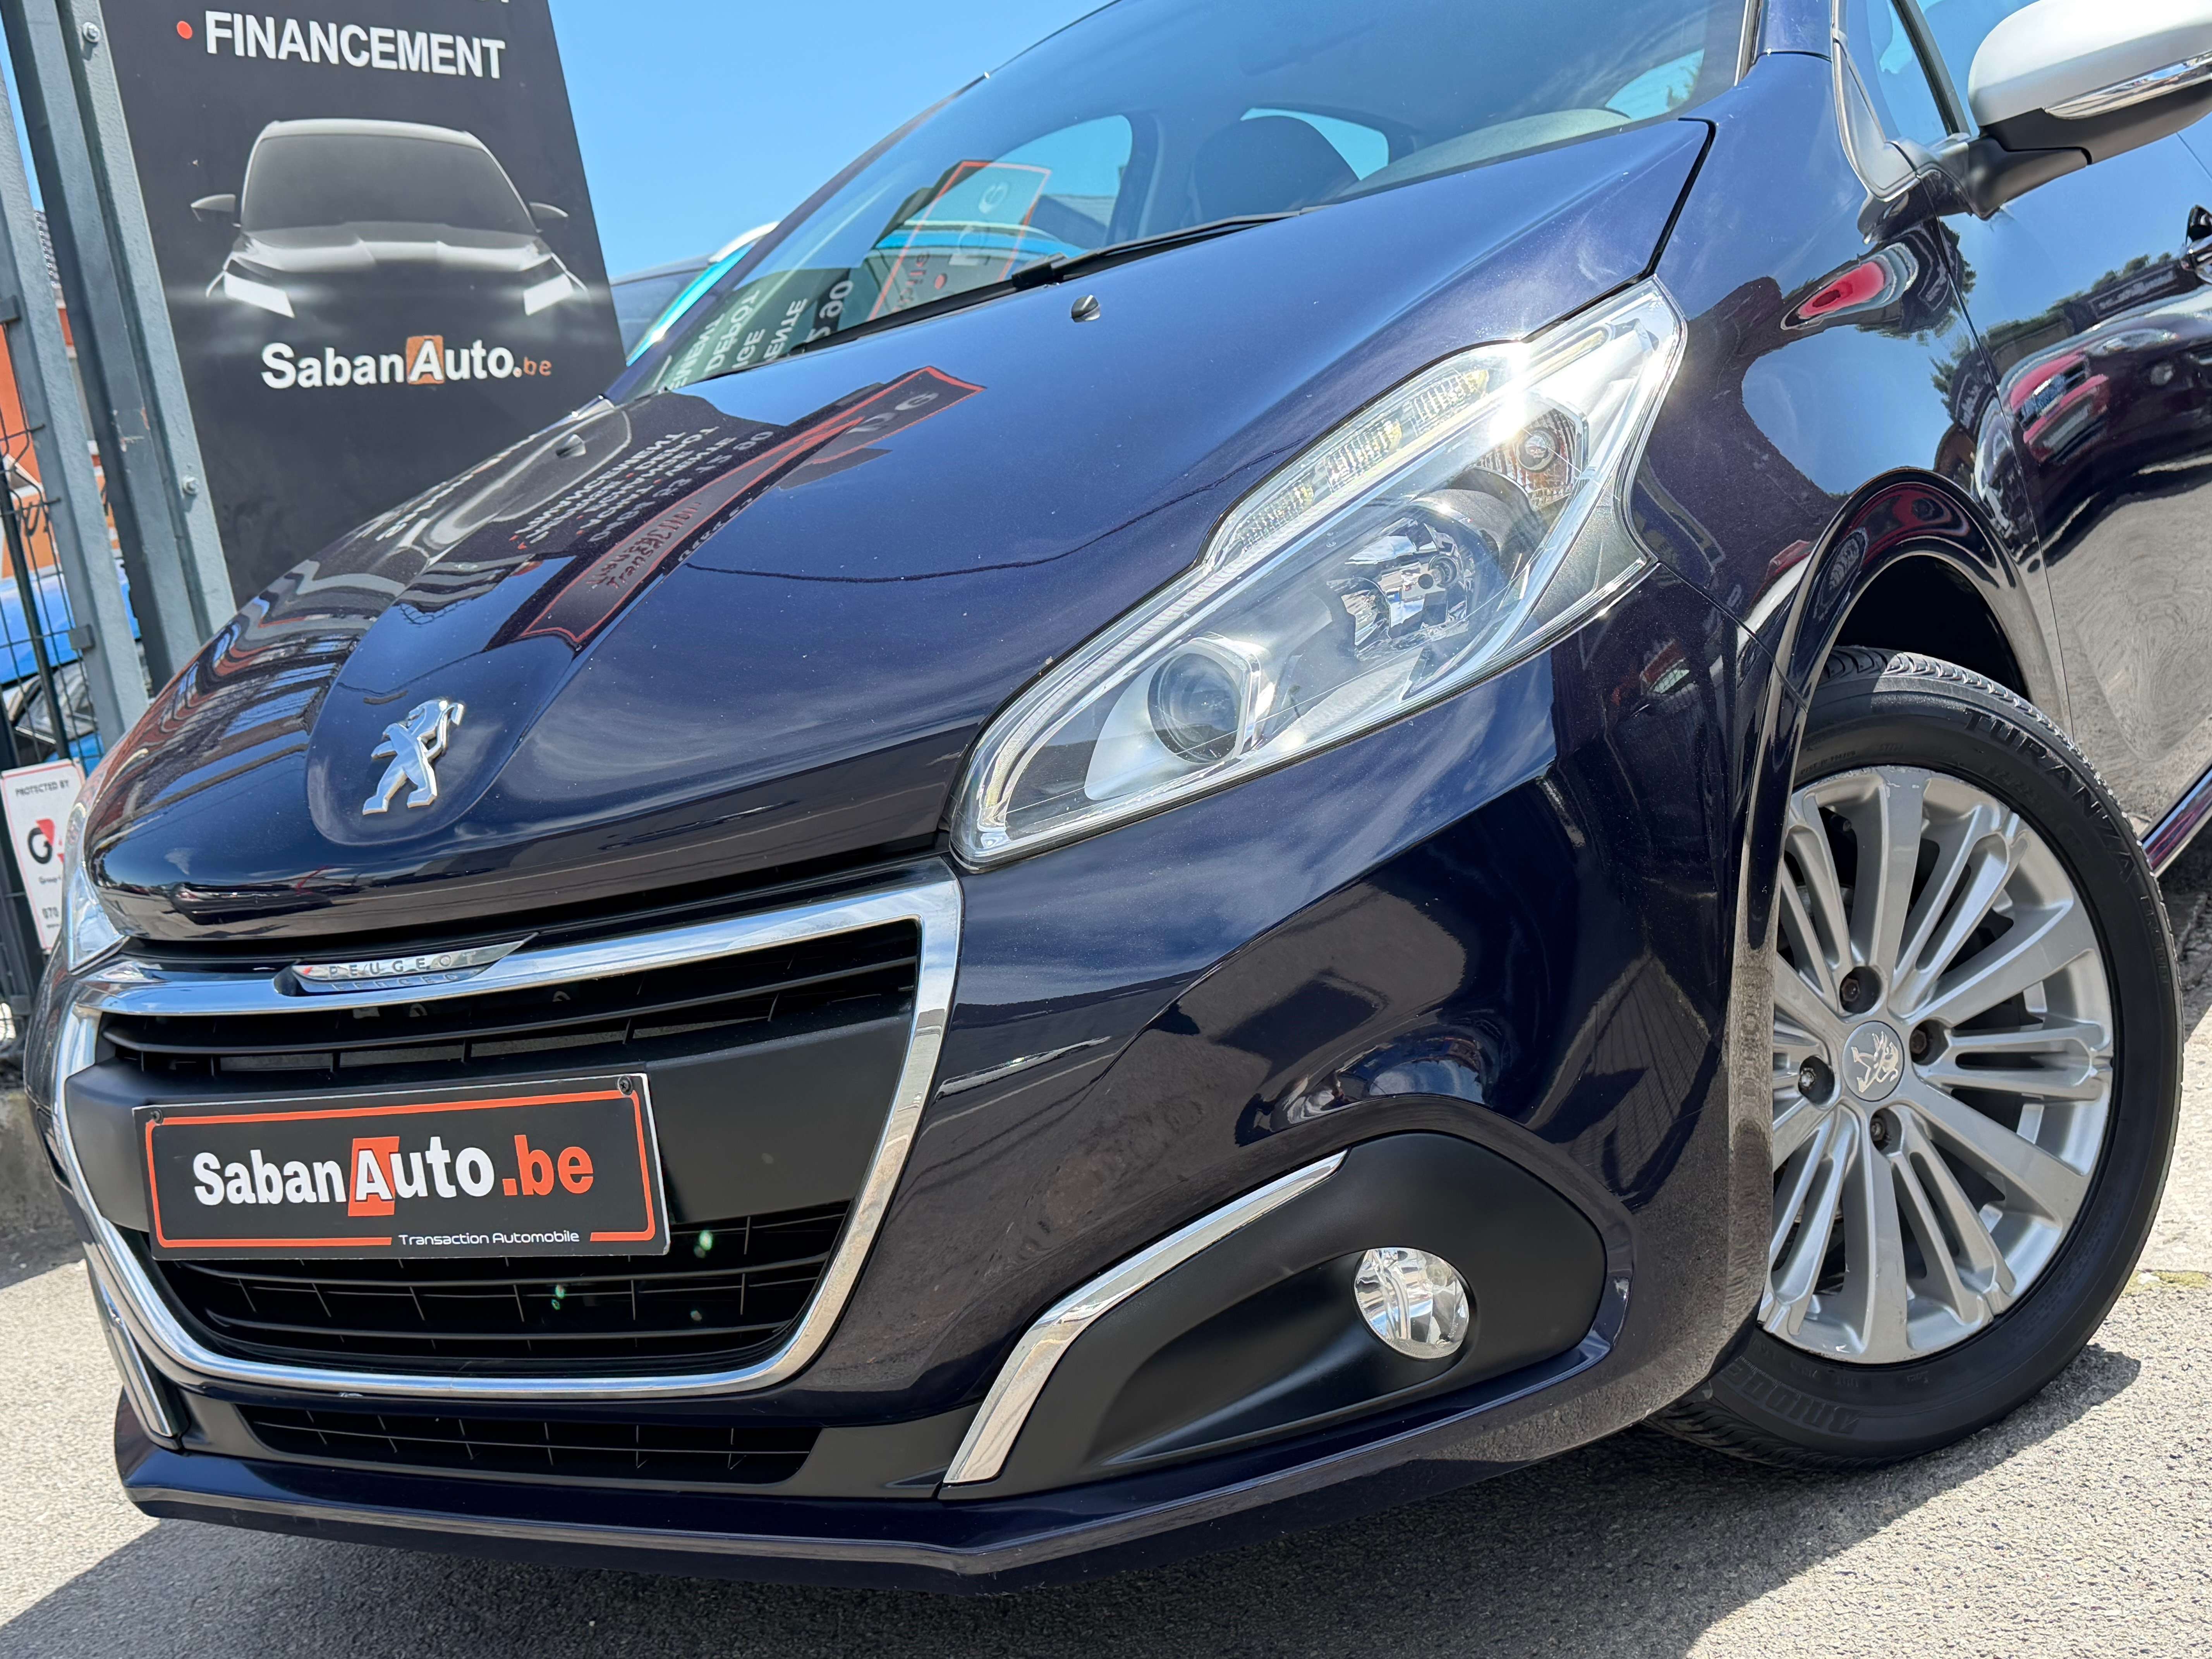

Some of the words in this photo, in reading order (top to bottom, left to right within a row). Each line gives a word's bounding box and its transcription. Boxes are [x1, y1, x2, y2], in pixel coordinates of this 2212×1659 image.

[205, 10, 505, 79] FINANCEMENT
[261, 339, 552, 389] SabanAuto.be
[328, 951, 476, 980] PEUGEOT
[193, 1134, 594, 1206] SabanAuto.be
[398, 1233, 489, 1245] Transaction
[493, 1230, 580, 1243] Automobile
